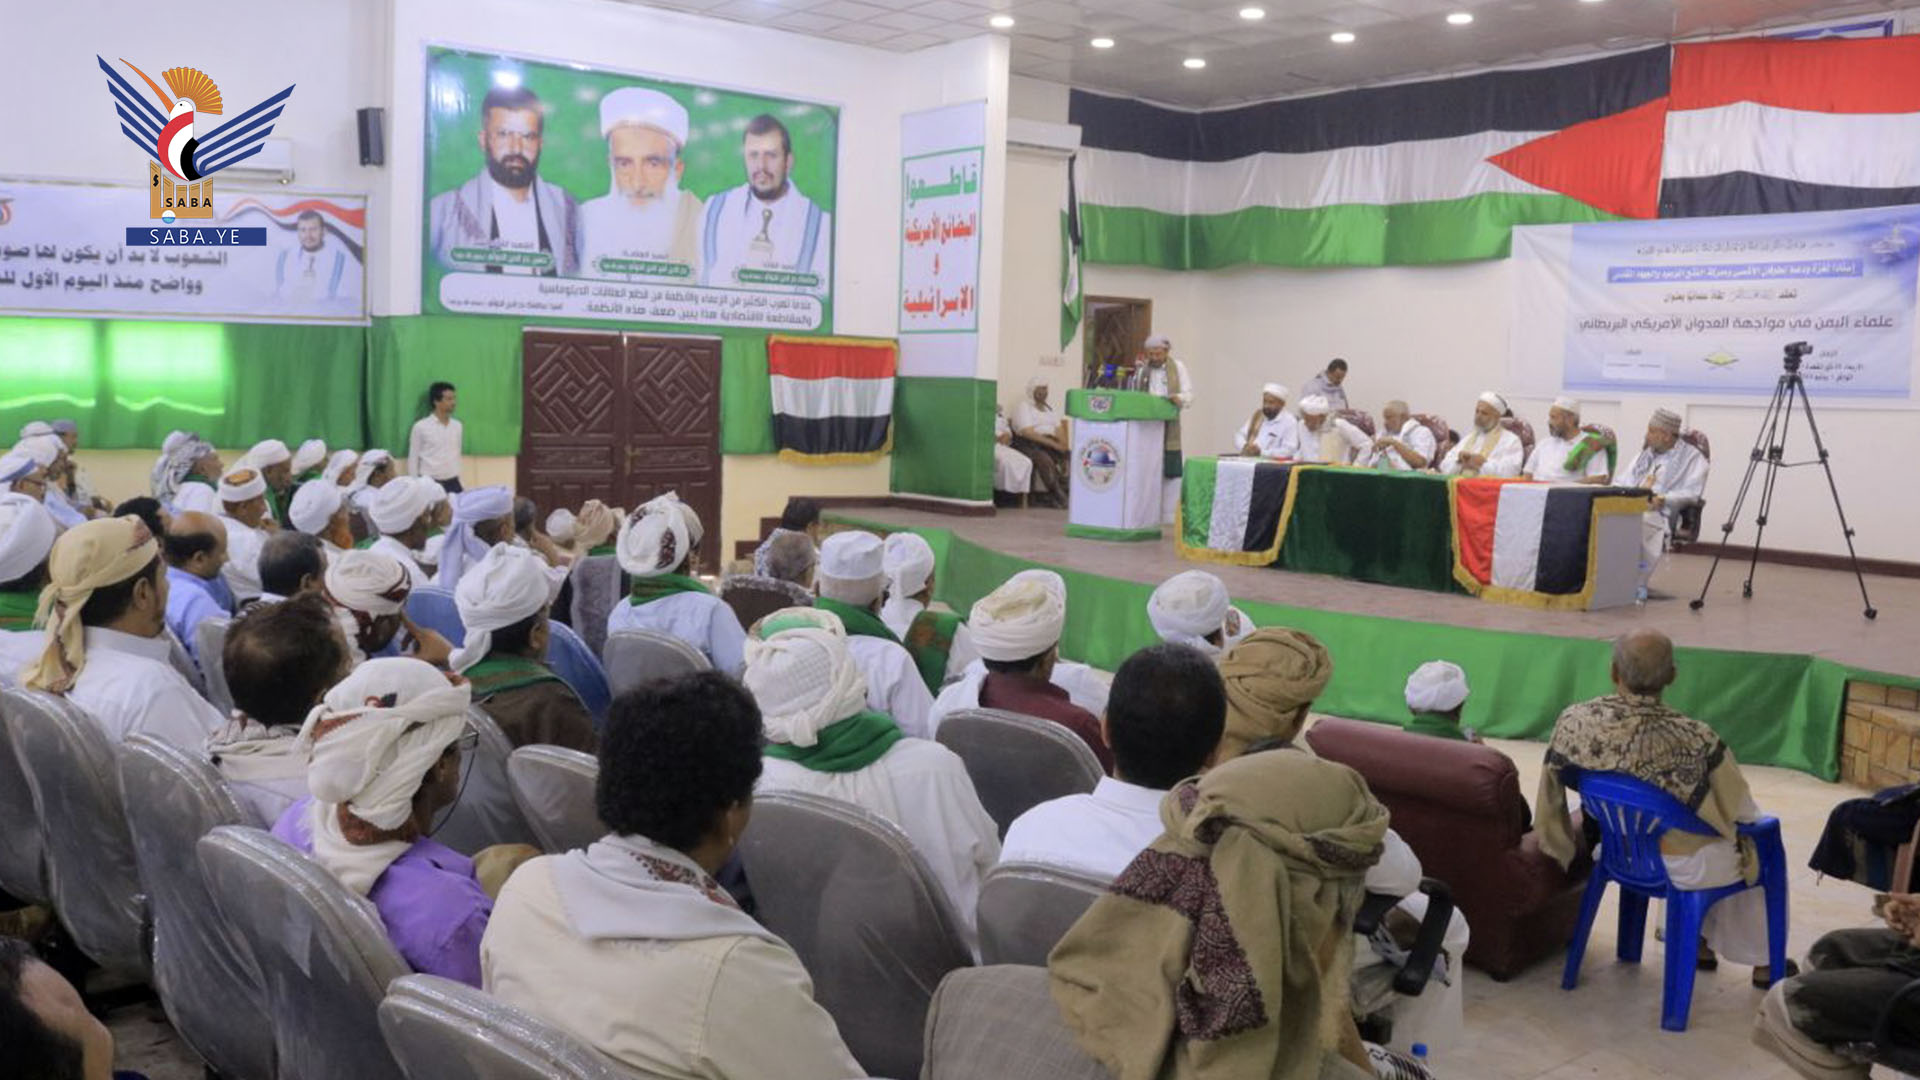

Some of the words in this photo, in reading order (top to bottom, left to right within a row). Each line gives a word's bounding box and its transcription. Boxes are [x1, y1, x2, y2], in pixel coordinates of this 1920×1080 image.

[906, 163, 977, 208] قاطعوا
[941, 213, 976, 245] البضائع
[36, 244, 56, 260] لها
[62, 246, 100, 264] يكون
[151, 247, 159, 263] لا
[164, 251, 228, 266] الشعوب
[933, 253, 940, 275] و
[22, 267, 59, 289] الأول
[64, 273, 108, 292] اليوم
[114, 276, 144, 289] منذ
[150, 274, 203, 294] وواضح
[1732, 317, 1785, 331] مواجهة
[1815, 316, 1849, 330] اليمن
[1854, 315, 1893, 328] علماء
